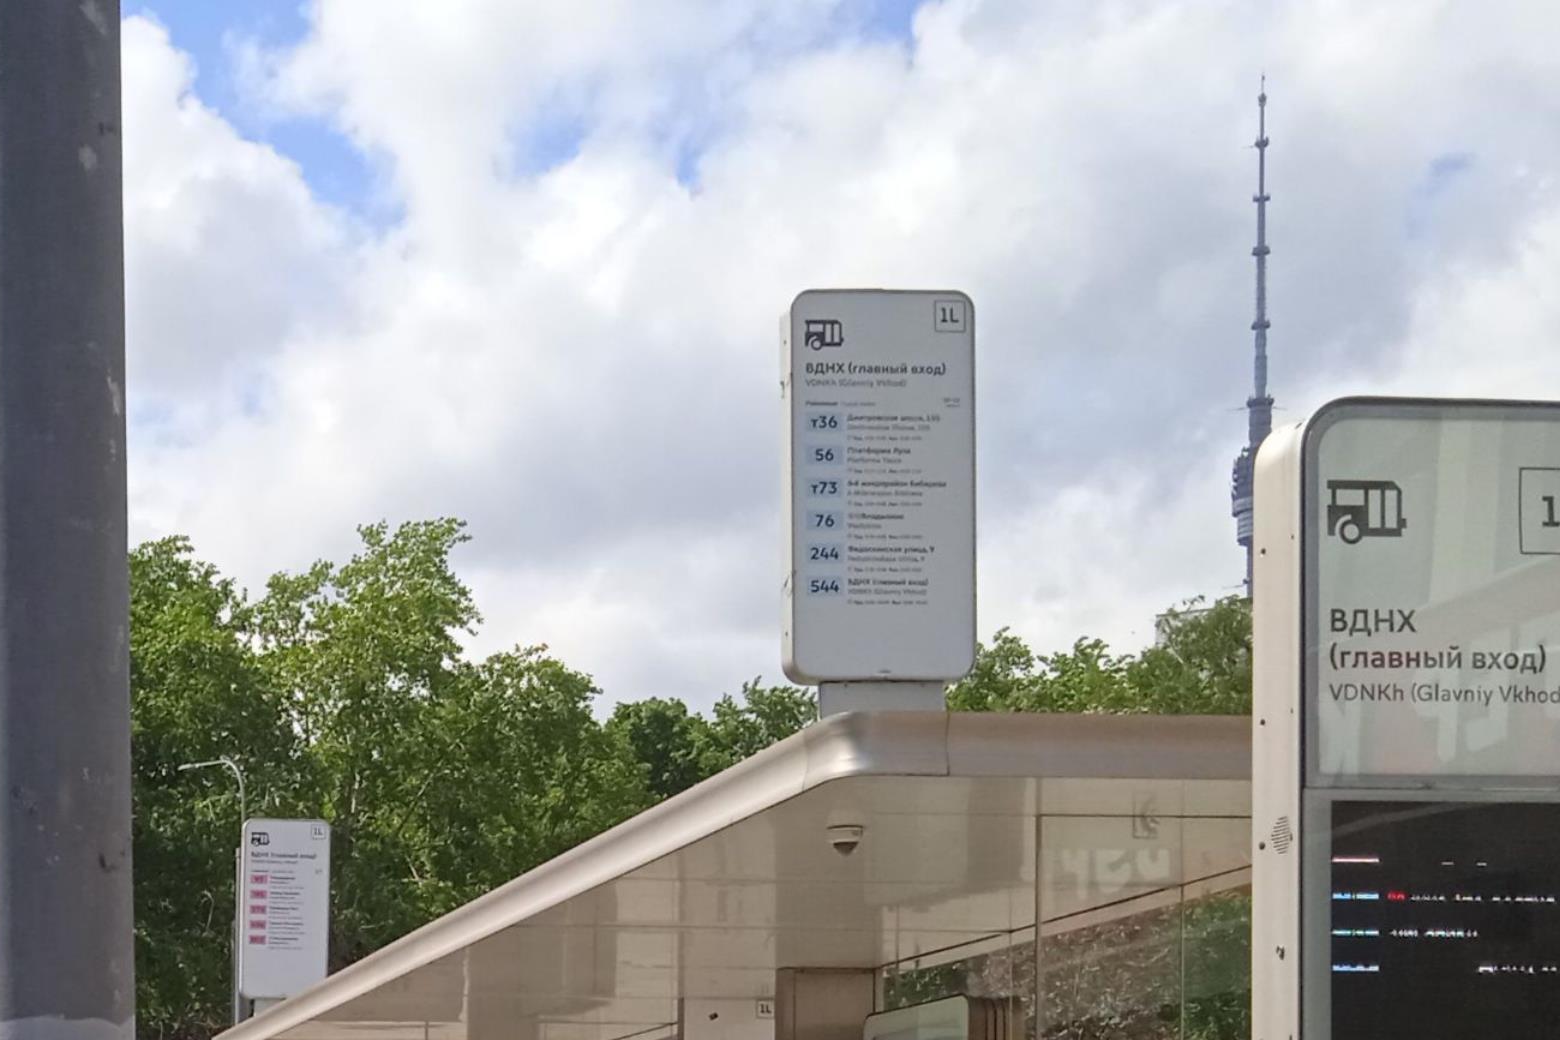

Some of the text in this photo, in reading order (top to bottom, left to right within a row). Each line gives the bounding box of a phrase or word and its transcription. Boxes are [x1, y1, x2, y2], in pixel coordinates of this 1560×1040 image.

[940, 307, 960, 323] 1L
[805, 361, 947, 375] ВДНХ (главный вход)
[815, 449, 834, 462] 56
[815, 514, 835, 527] 76
[810, 547, 839, 560] 244
[810, 580, 839, 593] 544
[1329, 608, 1417, 637] ВДНХ
[1329, 642, 1547, 675] (главный вход)
[1329, 684, 1405, 702] VDNKh
[1410, 682, 1493, 707] (Glavniy
[759, 1003, 772, 1015] 1L
